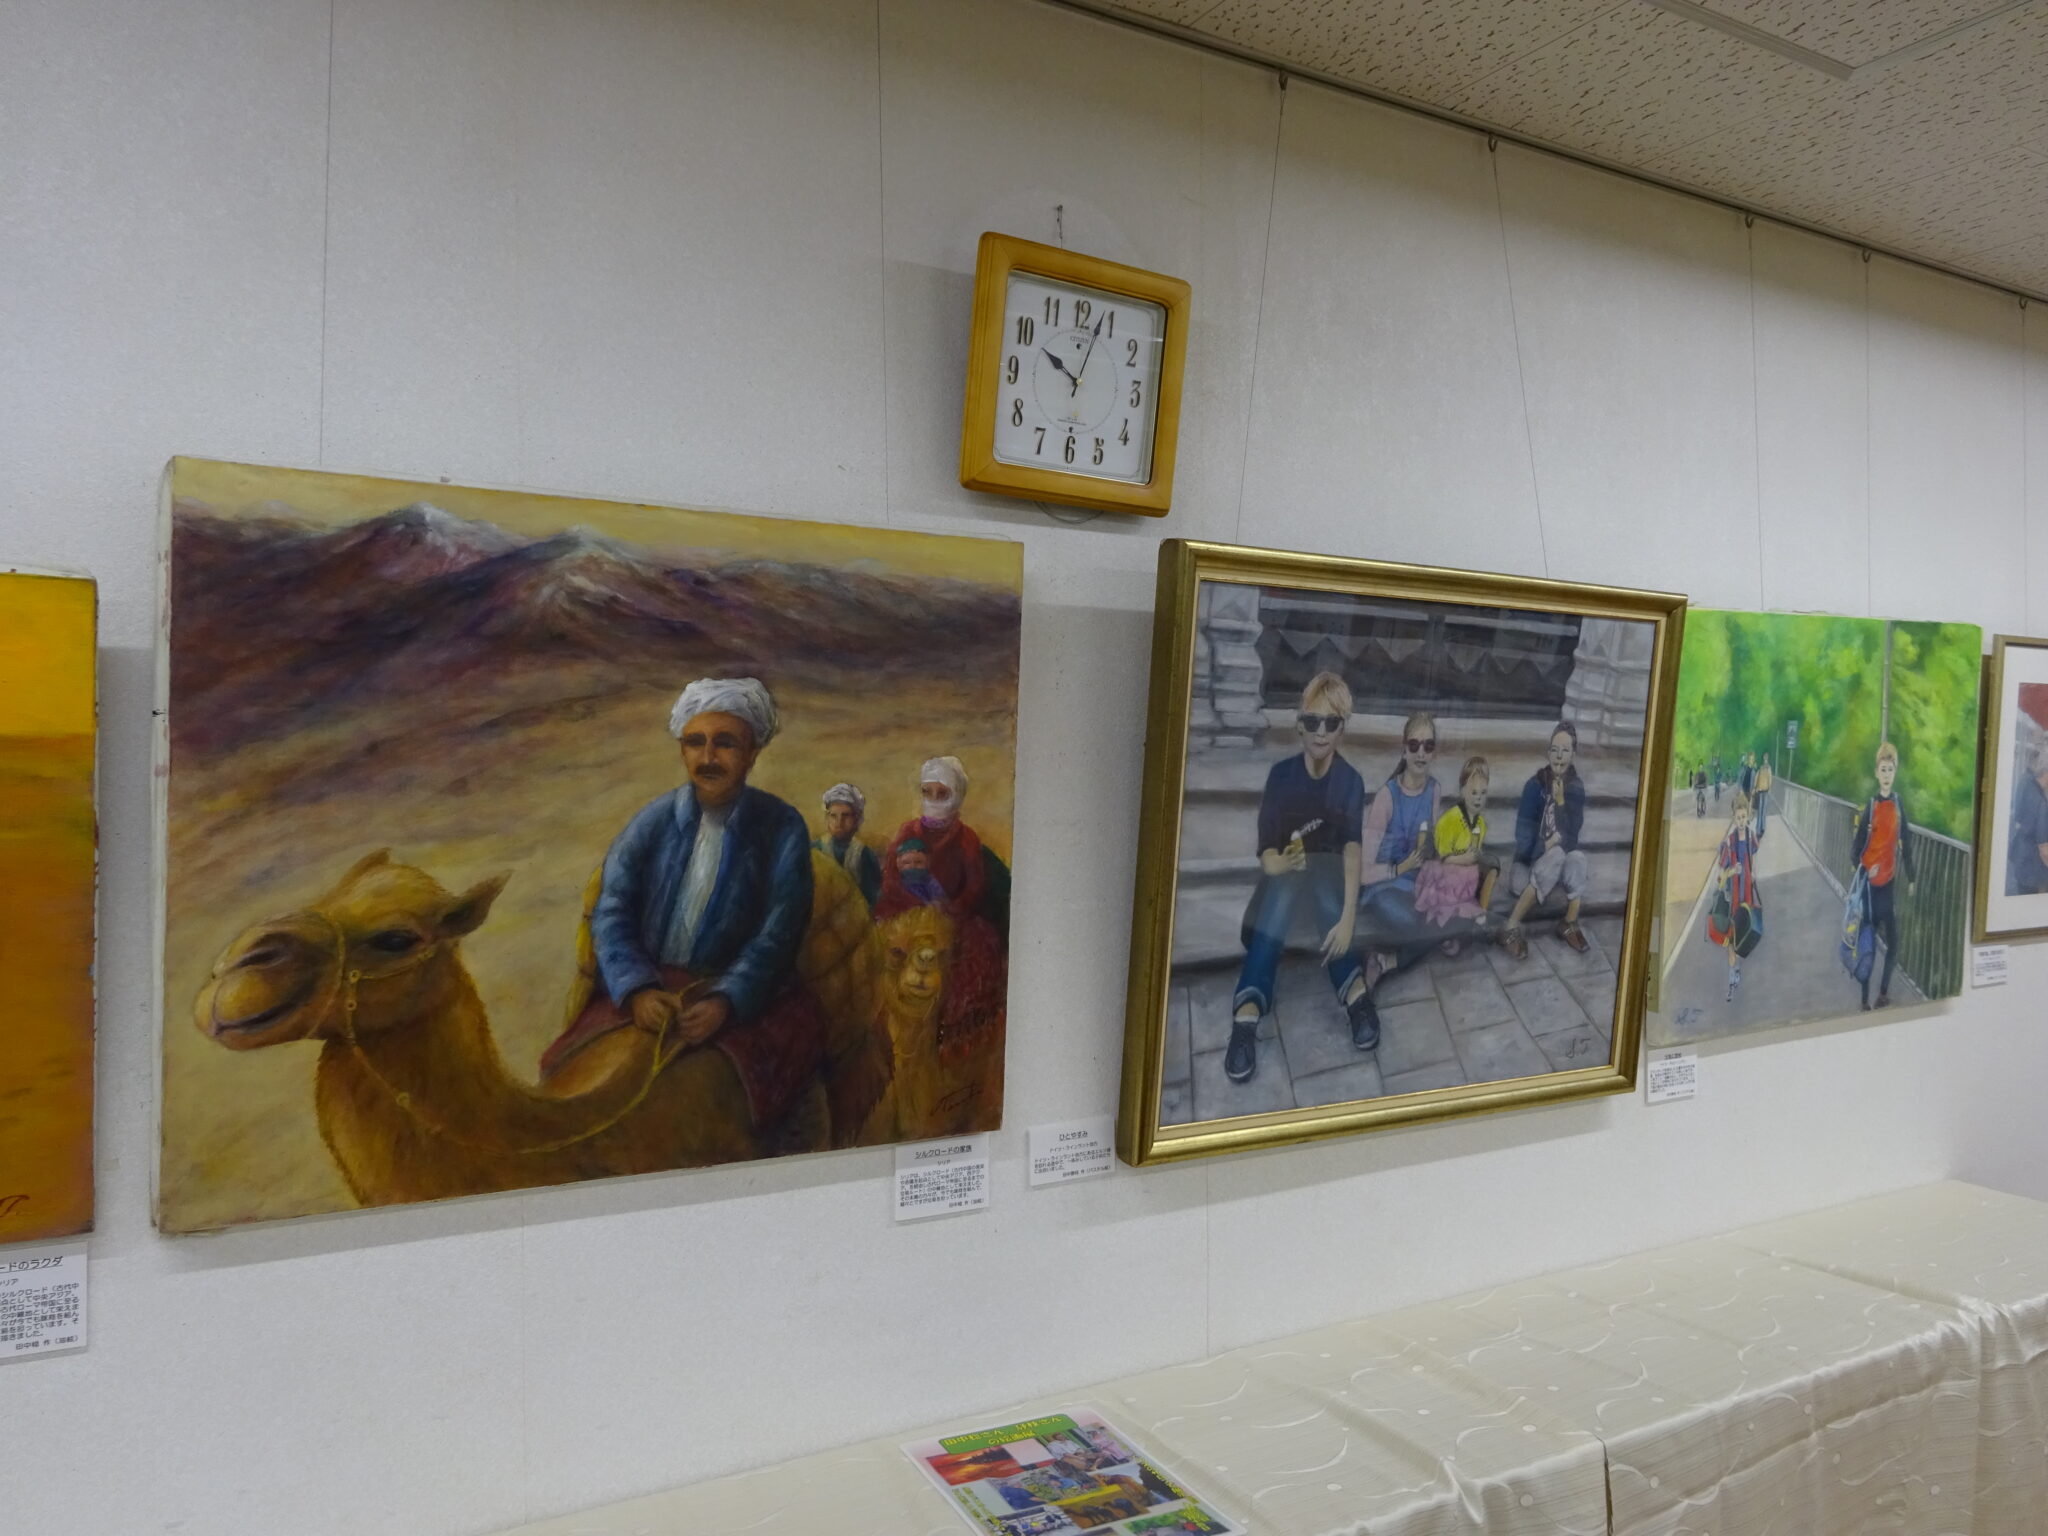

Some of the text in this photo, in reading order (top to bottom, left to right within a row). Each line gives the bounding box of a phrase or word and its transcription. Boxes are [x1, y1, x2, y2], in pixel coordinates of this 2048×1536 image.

[1043, 296, 1060, 327] 11
[1074, 300, 1091, 330] 12
[1107, 311, 1115, 338] 1
[1016, 316, 1034, 346] 10
[1126, 339, 1138, 367] 2
[1008, 356, 1019, 384] 9
[1130, 380, 1141, 408] 3
[1012, 398, 1023, 426] 8
[1034, 427, 1046, 455] 7
[1118, 419, 1129, 445] 4
[1065, 435, 1075, 463] 6
[1093, 437, 1105, 465] 5
[1059, 1130, 1088, 1141] ひとやすみ
